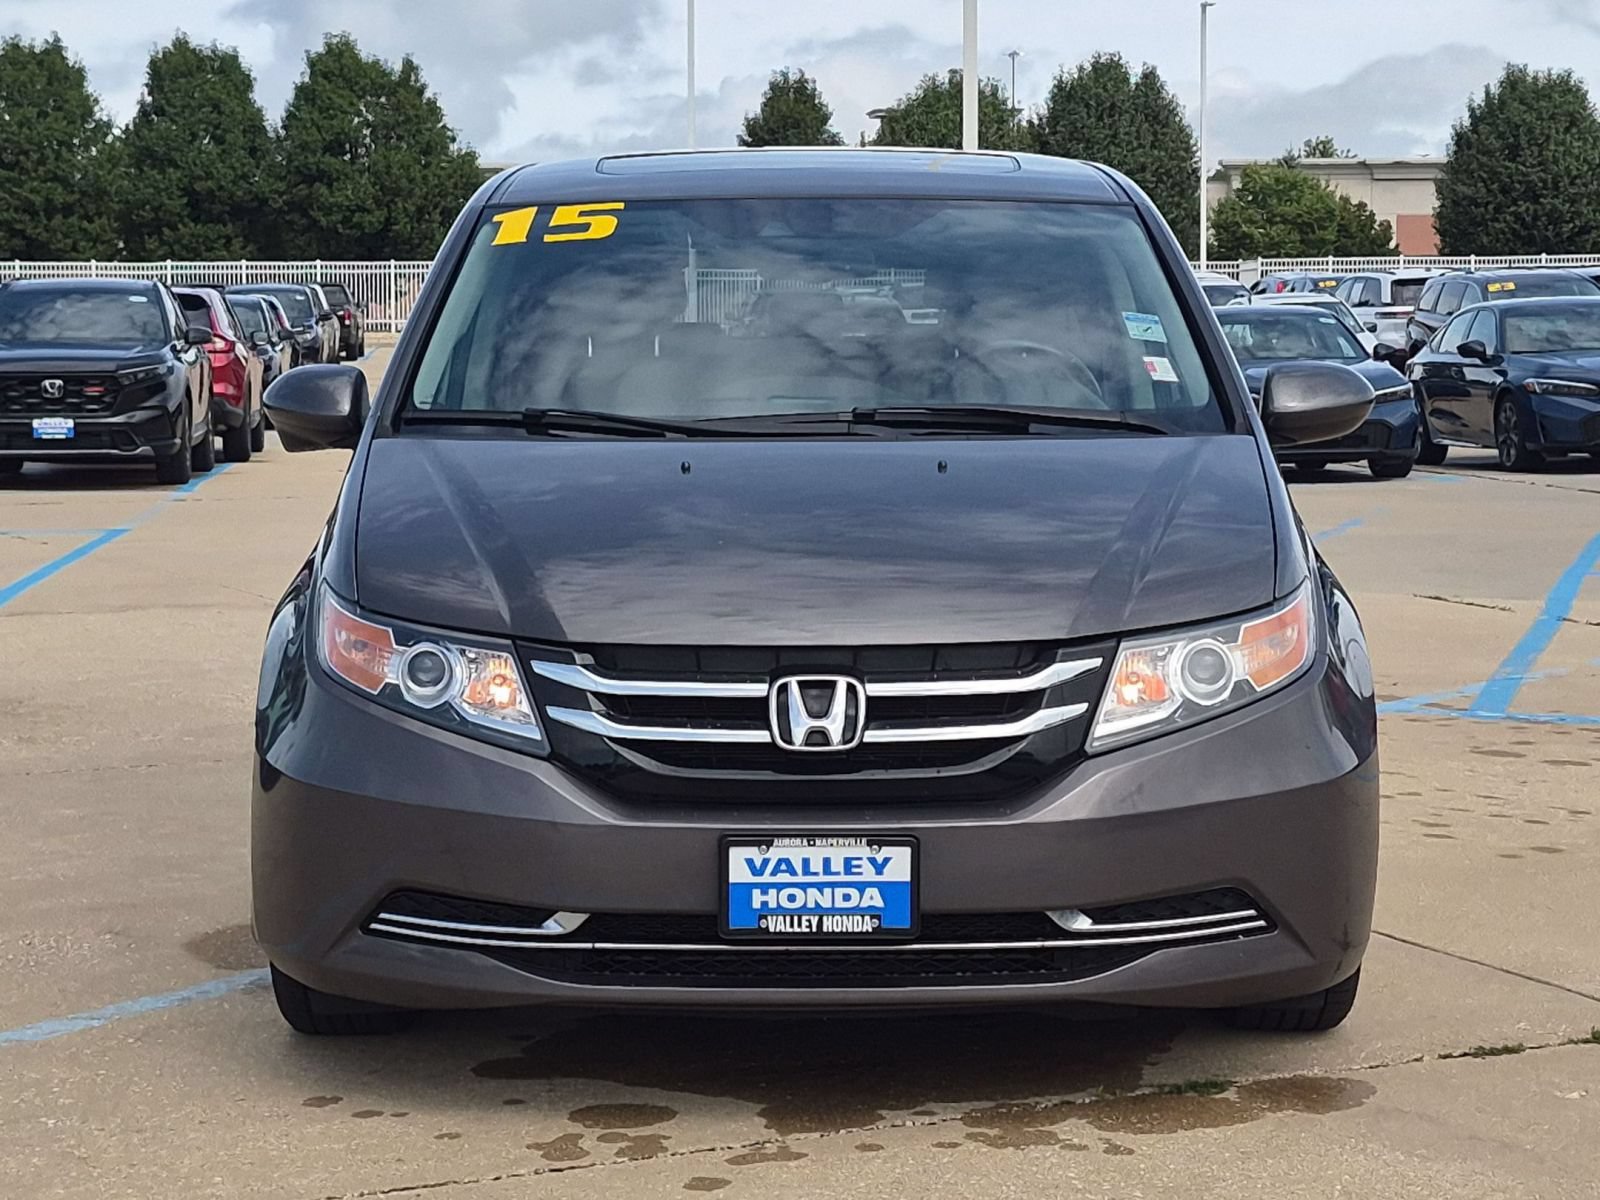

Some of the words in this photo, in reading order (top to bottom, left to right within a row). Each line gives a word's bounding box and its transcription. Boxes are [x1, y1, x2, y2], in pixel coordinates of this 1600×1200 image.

[491, 202, 625, 246] 15
[772, 837, 808, 847] AURORA
[815, 837, 867, 847] NAPERVILLE
[744, 856, 893, 877] VALLEY
[751, 887, 885, 909] HONDA
[767, 915, 819, 933] VALLEY
[822, 915, 873, 932] HONDA
